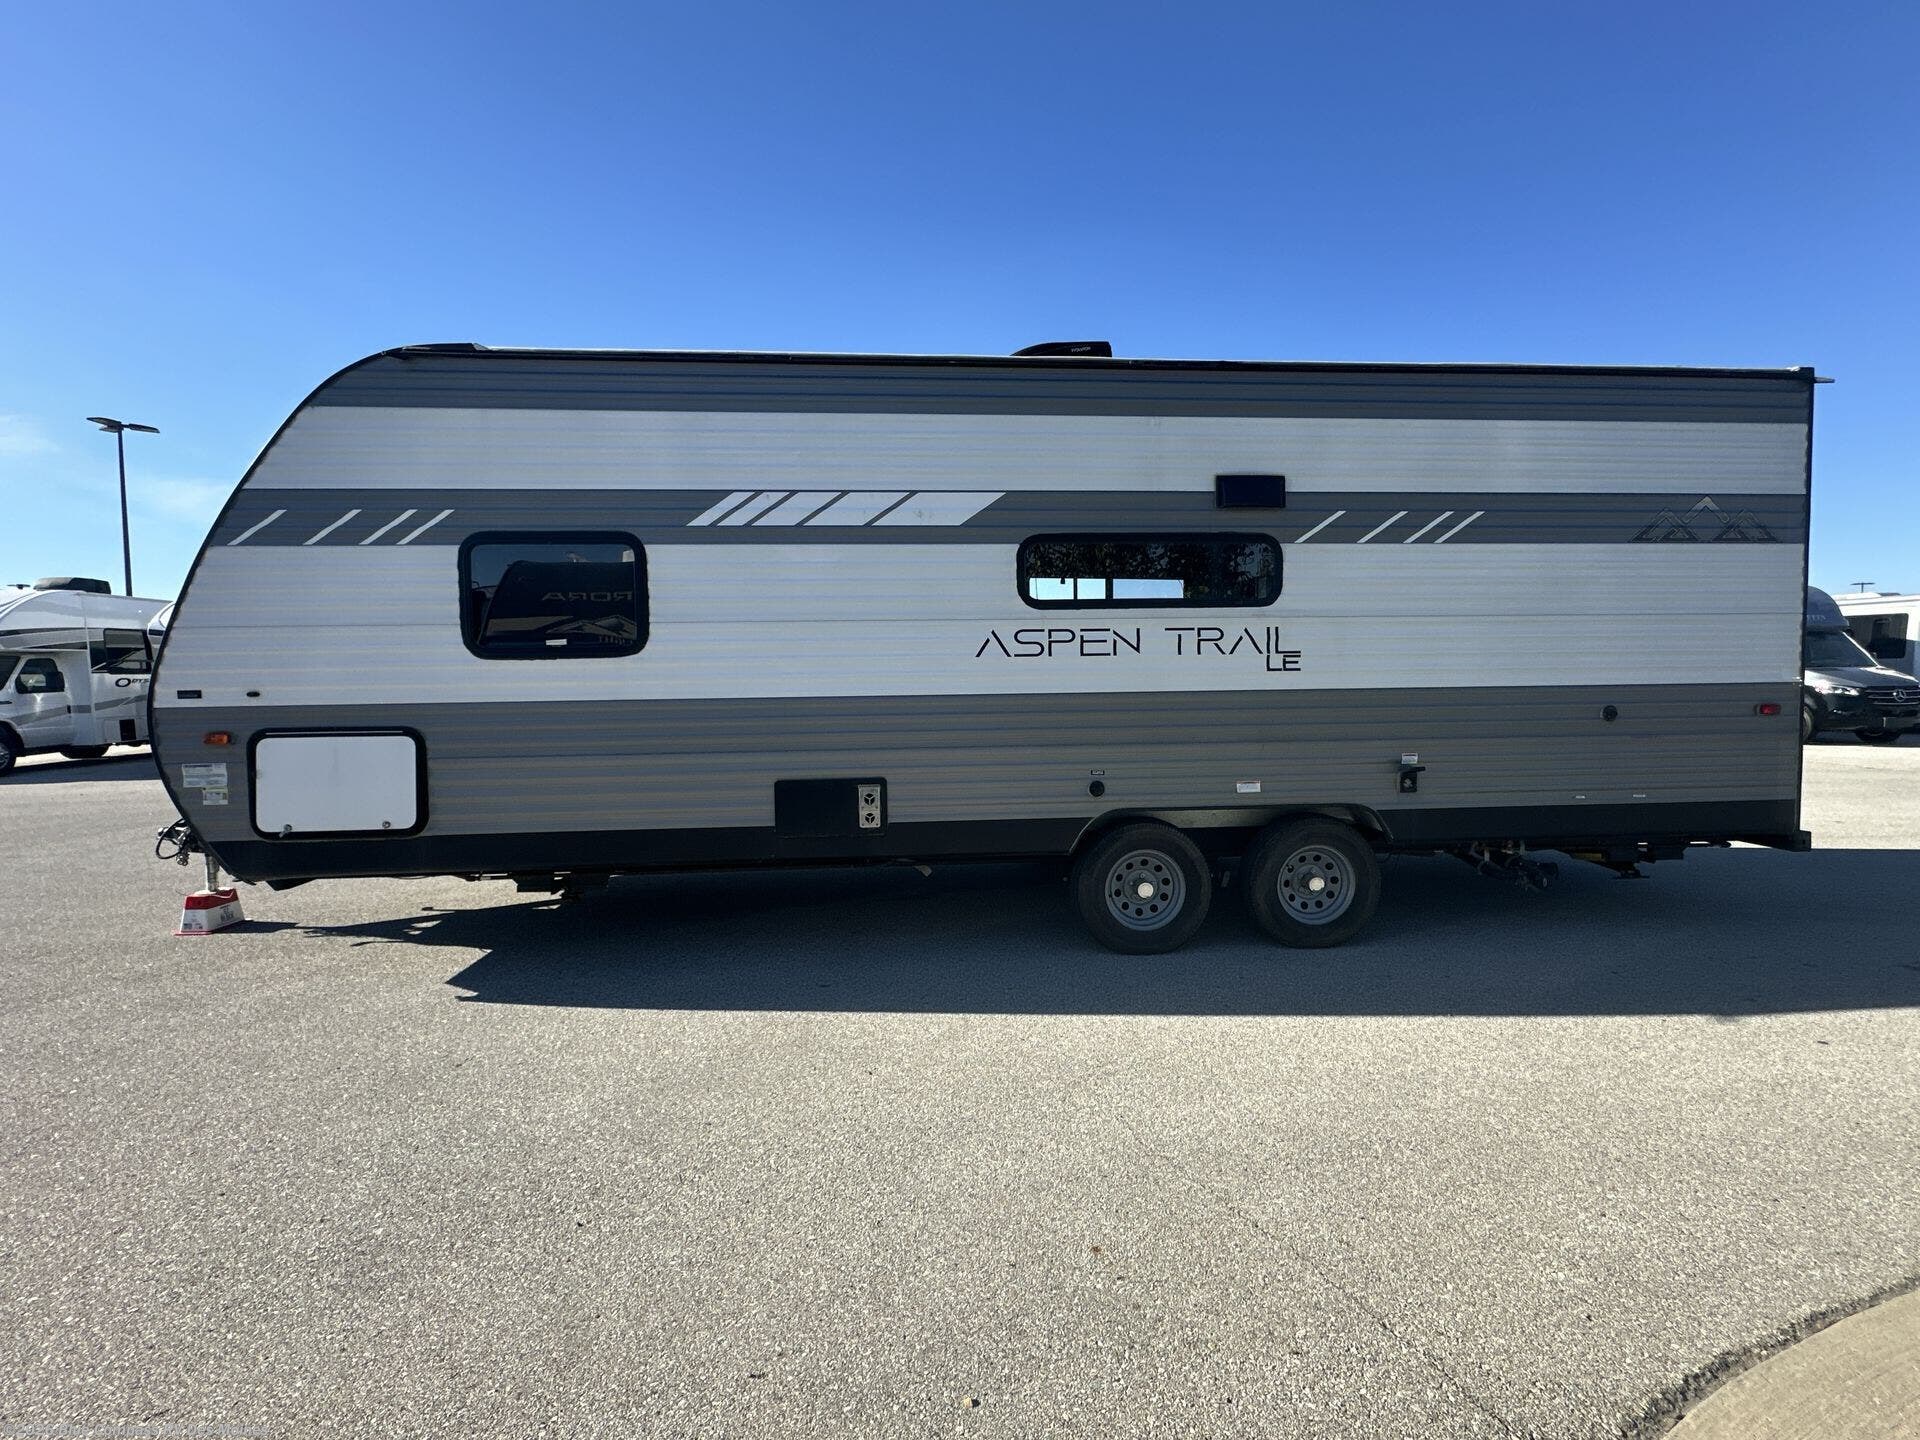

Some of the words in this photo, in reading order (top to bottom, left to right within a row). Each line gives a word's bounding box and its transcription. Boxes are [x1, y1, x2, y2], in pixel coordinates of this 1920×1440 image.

[975, 628, 1141, 658] ASPEN
[1164, 626, 1302, 656] TRAIL
[1266, 654, 1302, 672] LE
